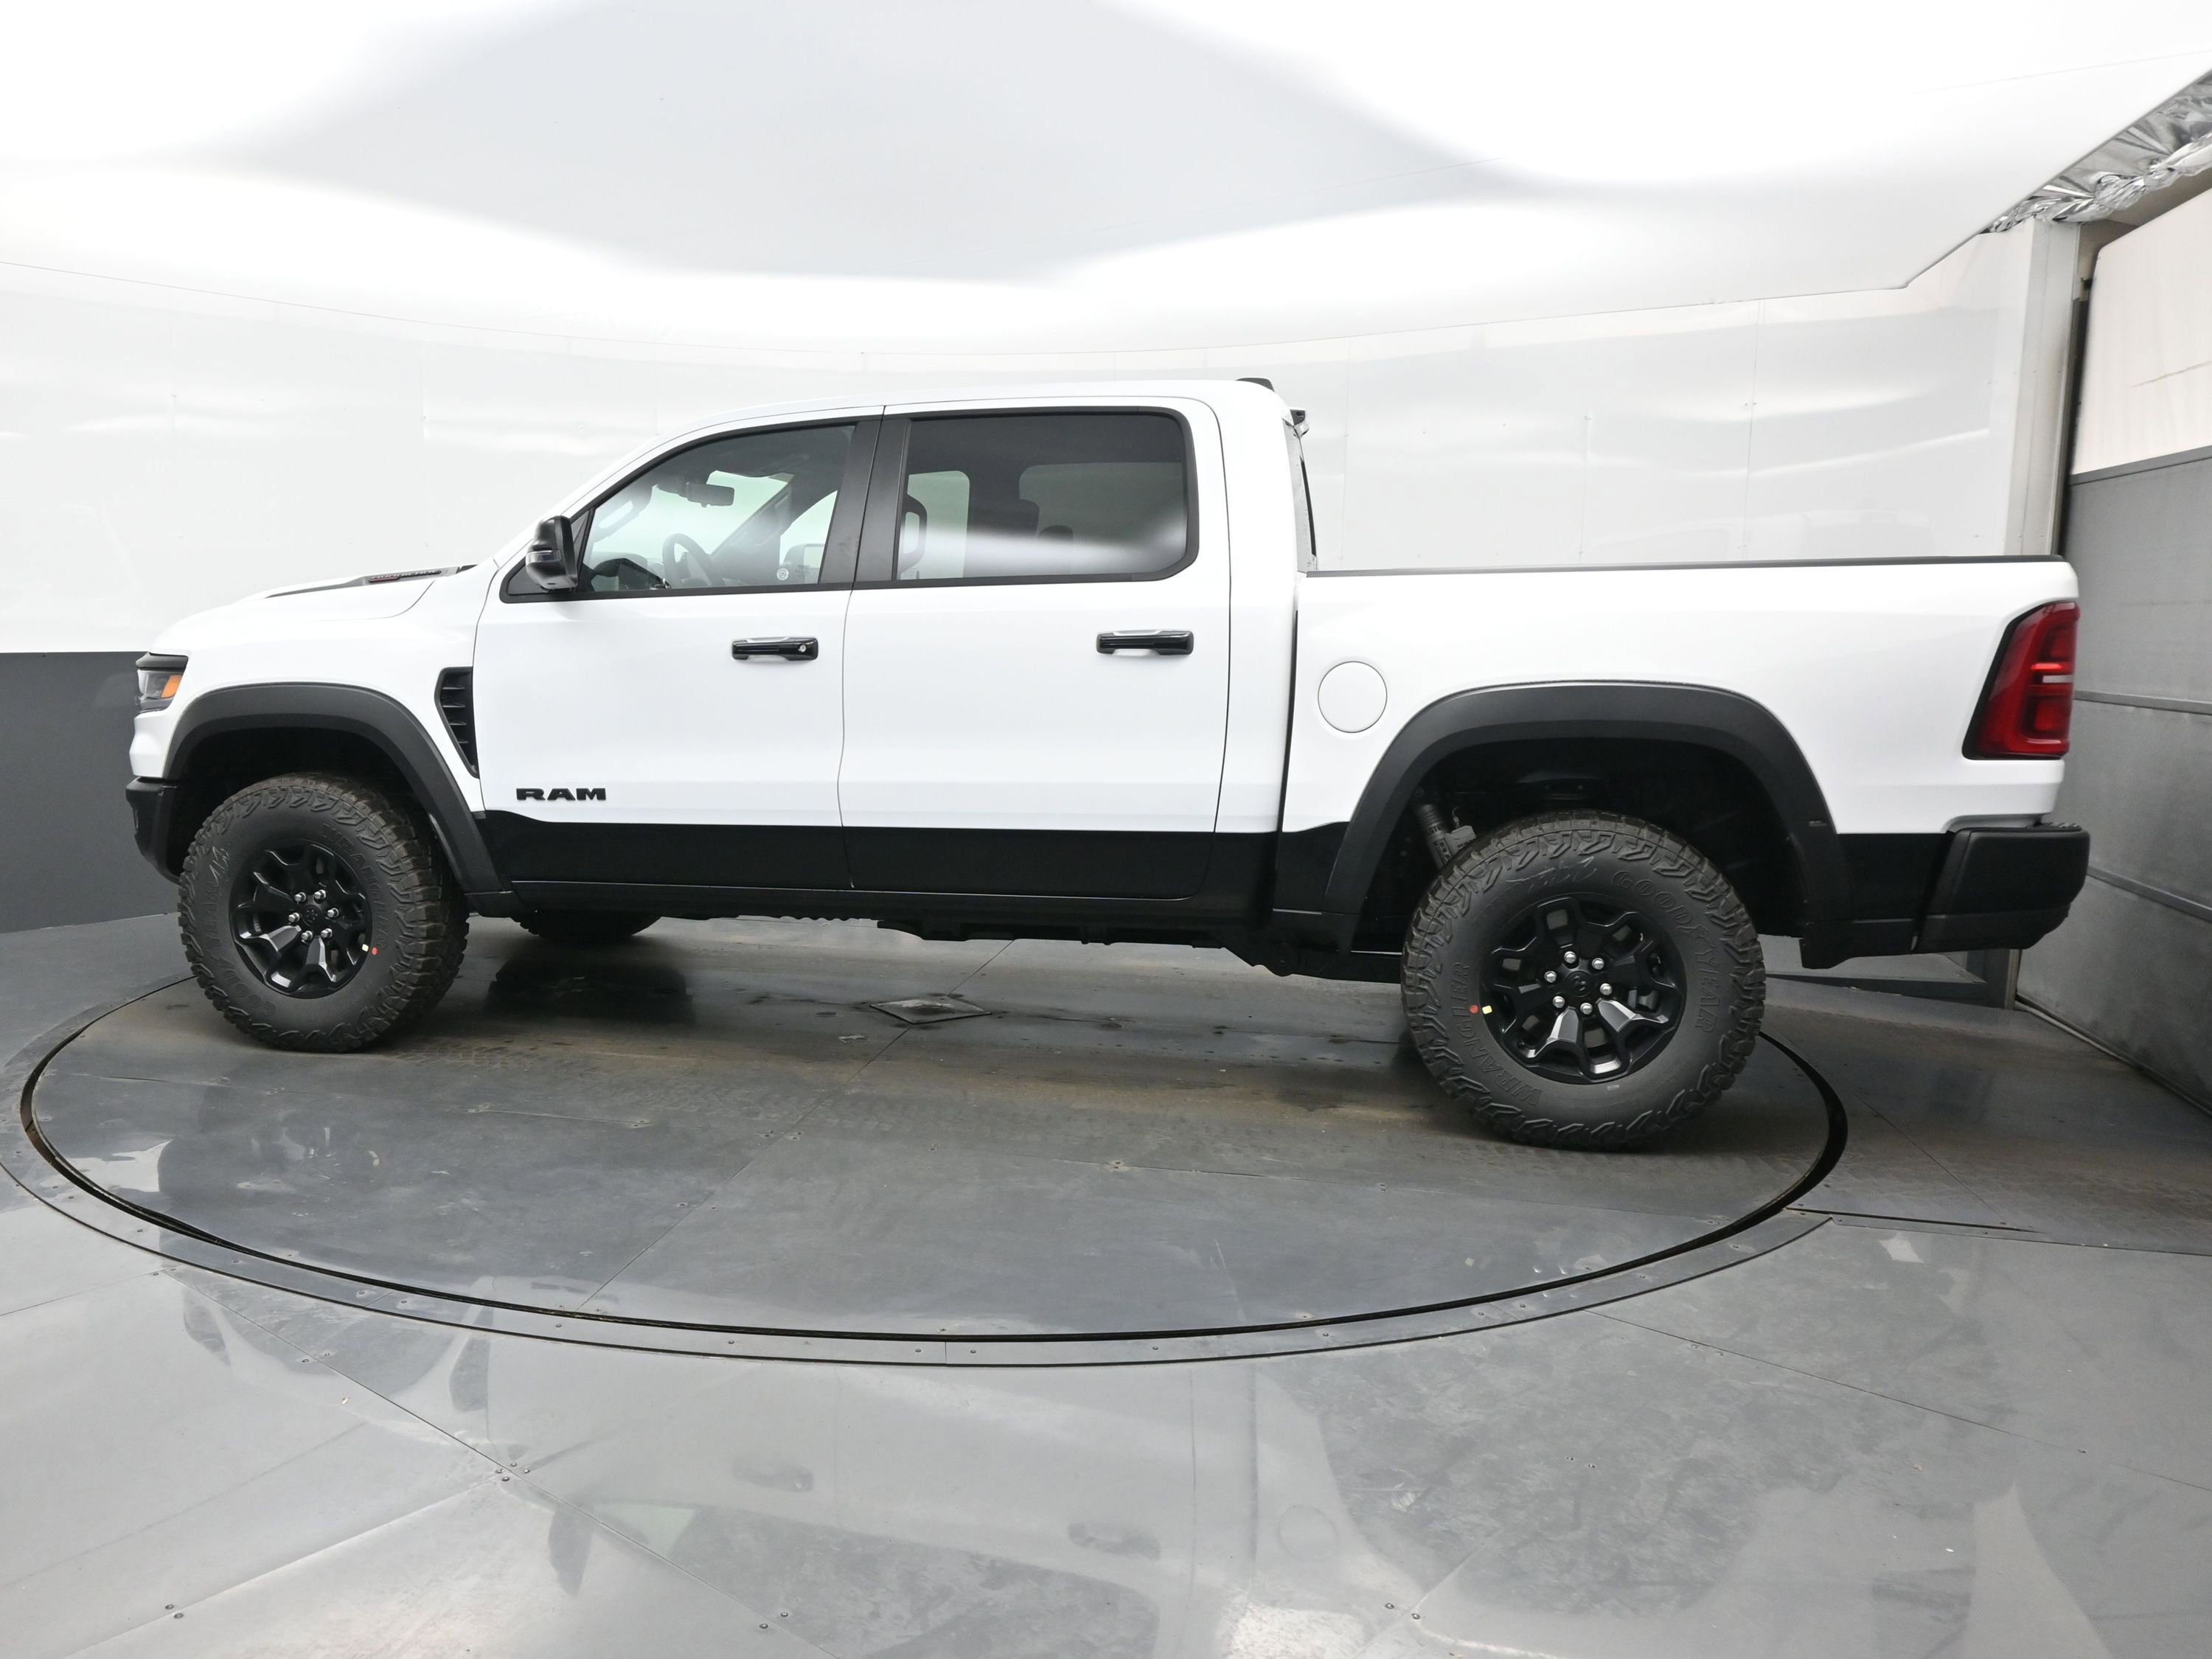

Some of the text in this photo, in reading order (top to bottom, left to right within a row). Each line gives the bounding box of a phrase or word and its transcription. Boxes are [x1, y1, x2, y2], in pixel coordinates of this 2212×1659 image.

[516, 787, 606, 801] RAM
[204, 883, 276, 1017] GOODYEAR
[320, 824, 388, 950] WRANGLER
[1612, 870, 1721, 1033] GOODYEAR
[1451, 961, 1543, 1106] WRANGLER
